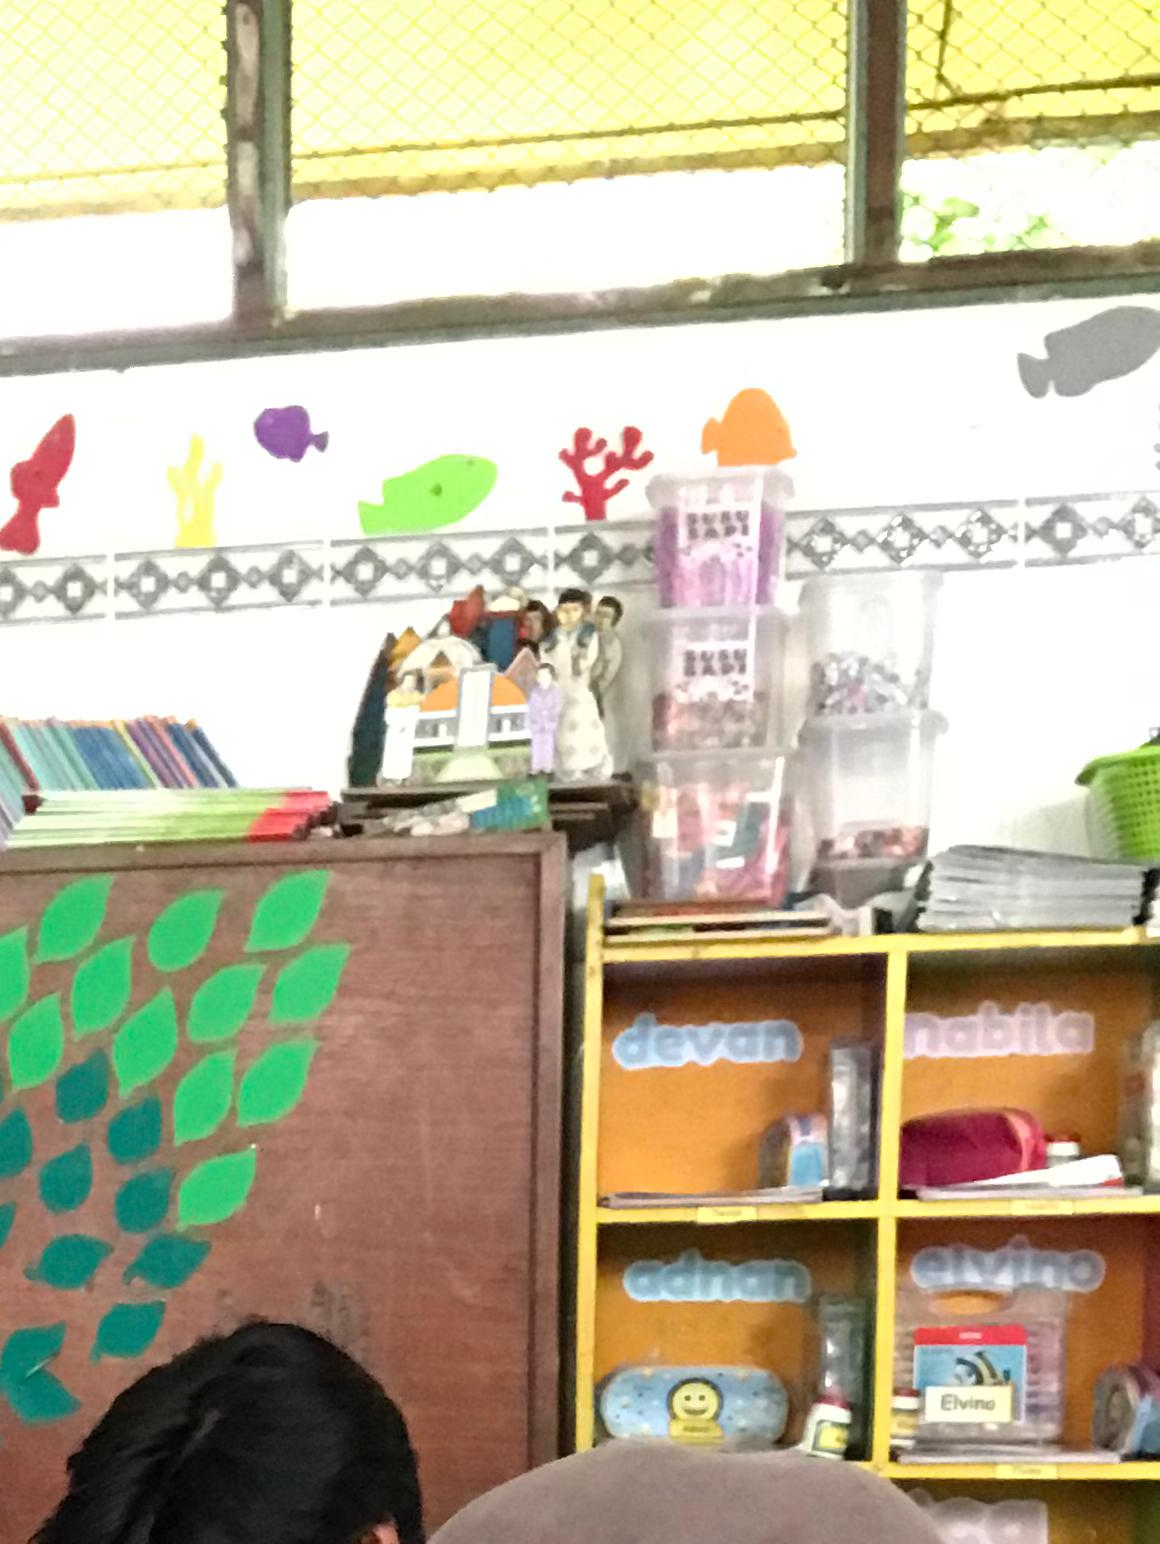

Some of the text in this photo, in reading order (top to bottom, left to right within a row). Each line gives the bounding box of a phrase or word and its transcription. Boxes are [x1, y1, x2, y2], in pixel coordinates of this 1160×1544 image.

[614, 1013, 802, 1067] devan
[904, 1001, 1094, 1057] nabila
[625, 1249, 810, 1302] adnan
[912, 1236, 1104, 1290] elvino
[940, 1393, 997, 1411] Elvino
